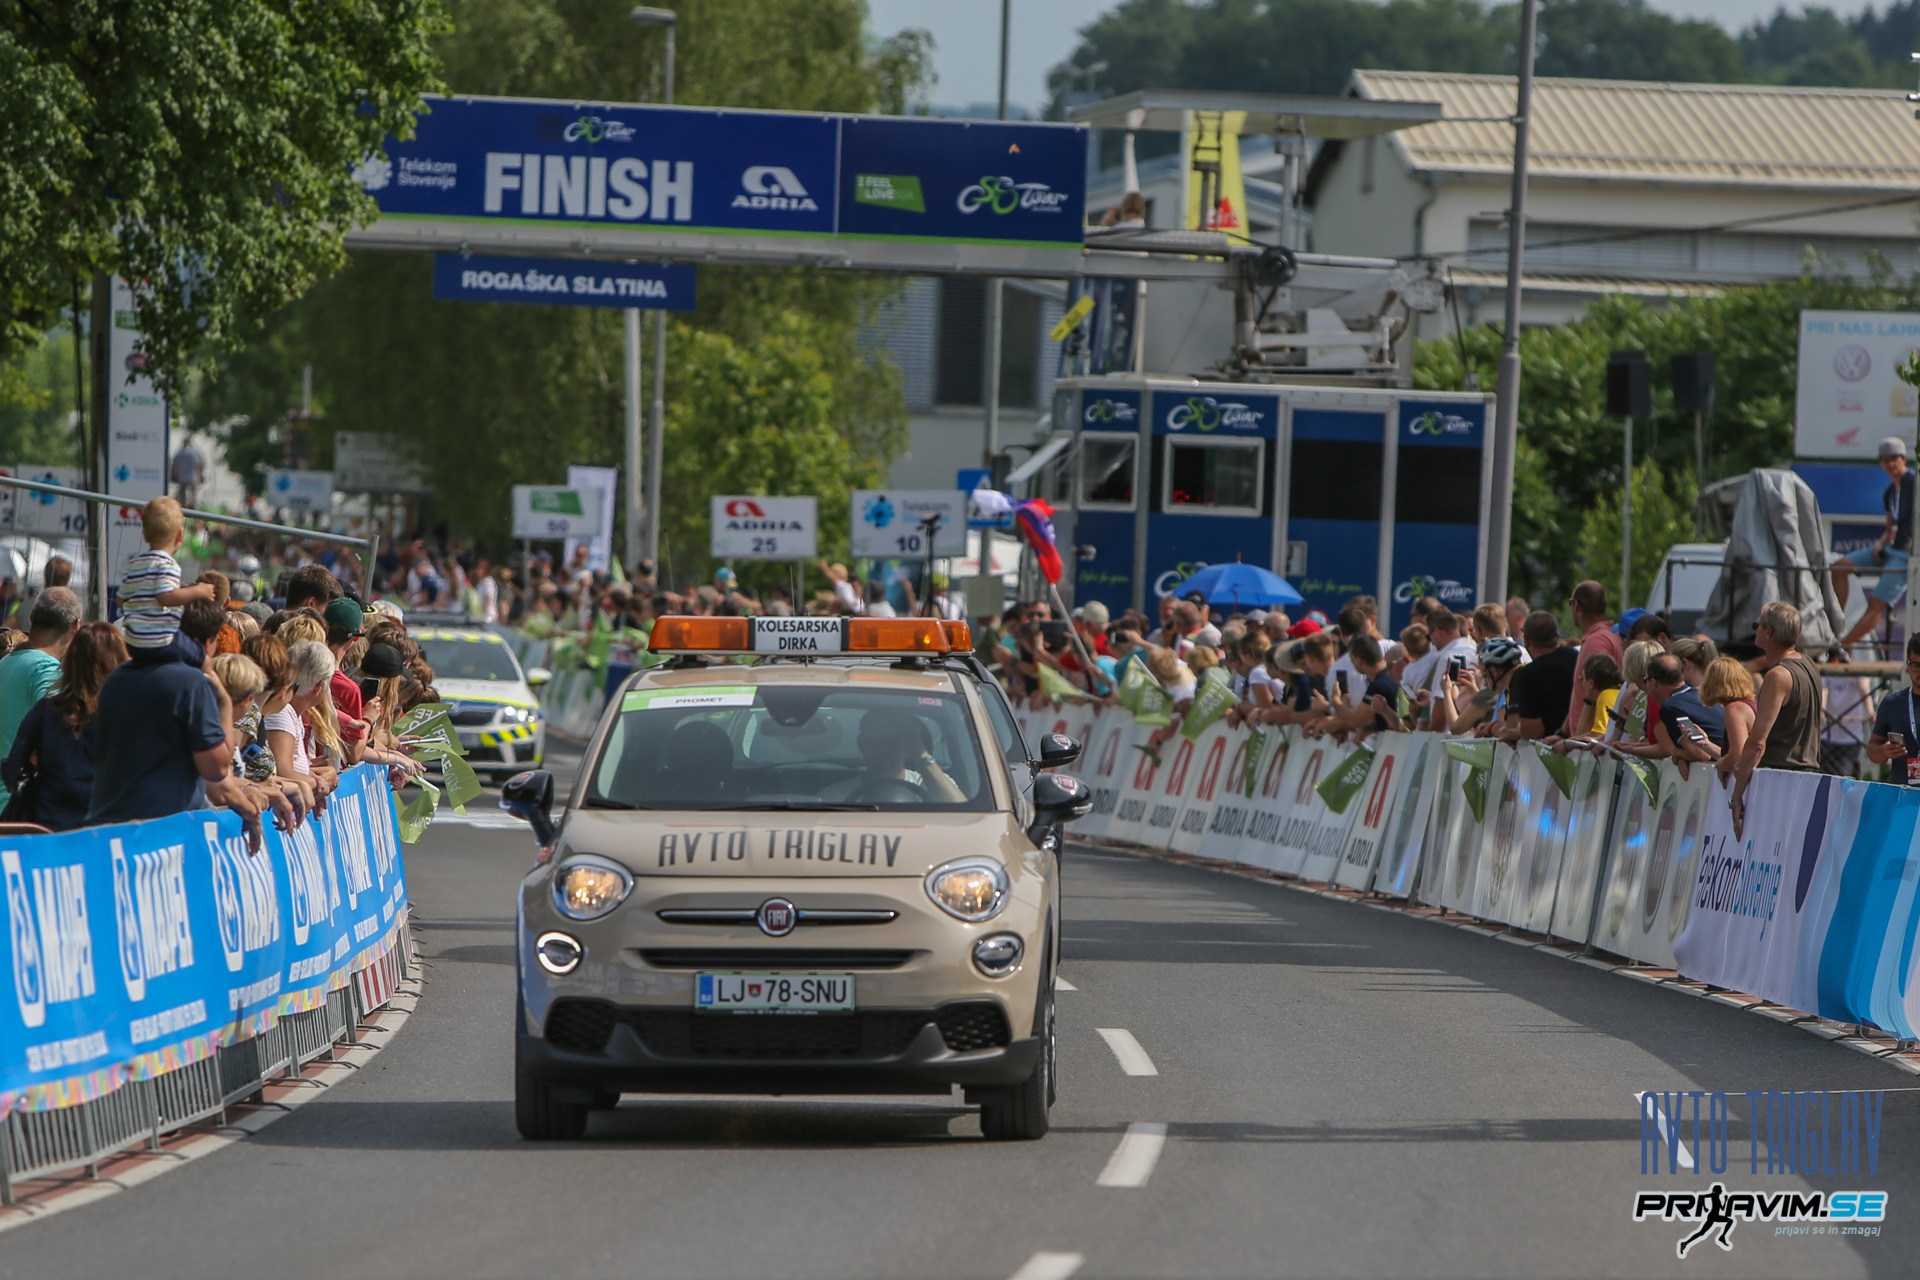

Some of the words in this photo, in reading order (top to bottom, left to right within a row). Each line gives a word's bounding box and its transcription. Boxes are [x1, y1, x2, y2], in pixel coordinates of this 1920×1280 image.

[399, 157, 457, 174] Telekom
[398, 173, 457, 190] Slovenije
[484, 152, 694, 221] FINISH
[865, 176, 893, 189] FEEL
[730, 194, 819, 211] ADRIA
[462, 269, 568, 294] ROGAŠKA
[573, 275, 667, 298] SLATINA
[1807, 320, 1834, 334] PRI
[1838, 321, 1873, 335] NAS
[902, 500, 951, 512] Telekom
[63, 514, 86, 532] 10
[726, 519, 803, 531] ADRIA
[752, 537, 777, 552] 25
[897, 535, 920, 552] 10
[757, 618, 839, 633] KOLESARSKA
[778, 637, 817, 650] DIRKA
[1116, 798, 1147, 822] ADRIA
[1149, 804, 1177, 829] ADRIA
[1180, 807, 1208, 835] ADRIA
[1209, 804, 1248, 837] ADRIA
[1247, 809, 1282, 844] ADRIA
[1277, 816, 1317, 850] ADRIA
[1311, 825, 1347, 858] ADRIA
[658, 830, 746, 867] AVTO
[767, 829, 902, 867] TRIGLAV
[1346, 836, 1374, 868] ADRIA
[767, 908, 788, 926] FIAT
[718, 979, 745, 1003] LJ
[764, 979, 847, 1003] 78-SNU
